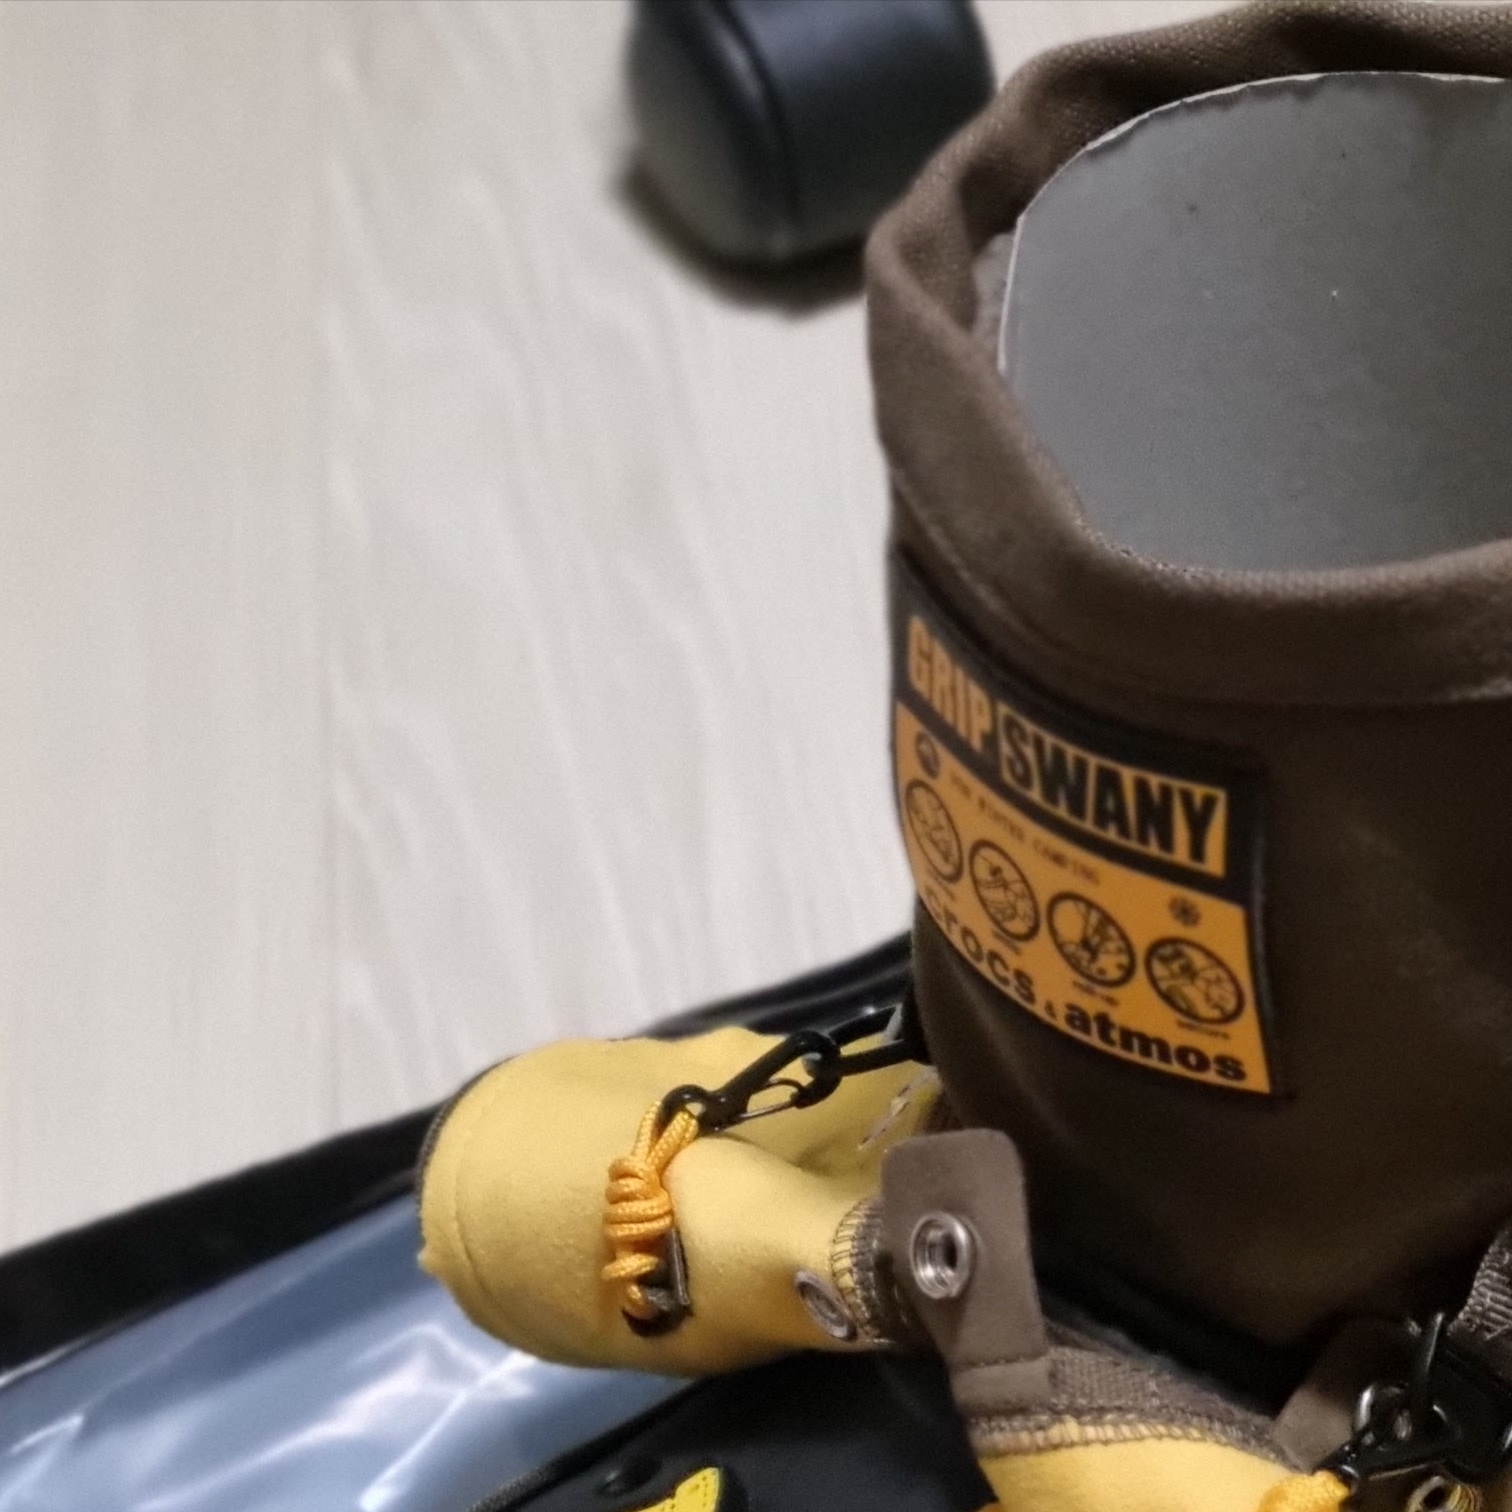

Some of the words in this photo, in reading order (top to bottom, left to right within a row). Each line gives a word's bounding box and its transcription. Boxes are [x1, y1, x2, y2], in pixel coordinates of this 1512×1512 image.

[908, 615, 994, 753] GRIP
[1001, 711, 1220, 864] SWANY
[924, 887, 1036, 1005] crocs
[1064, 1002, 1247, 1082] atmos
